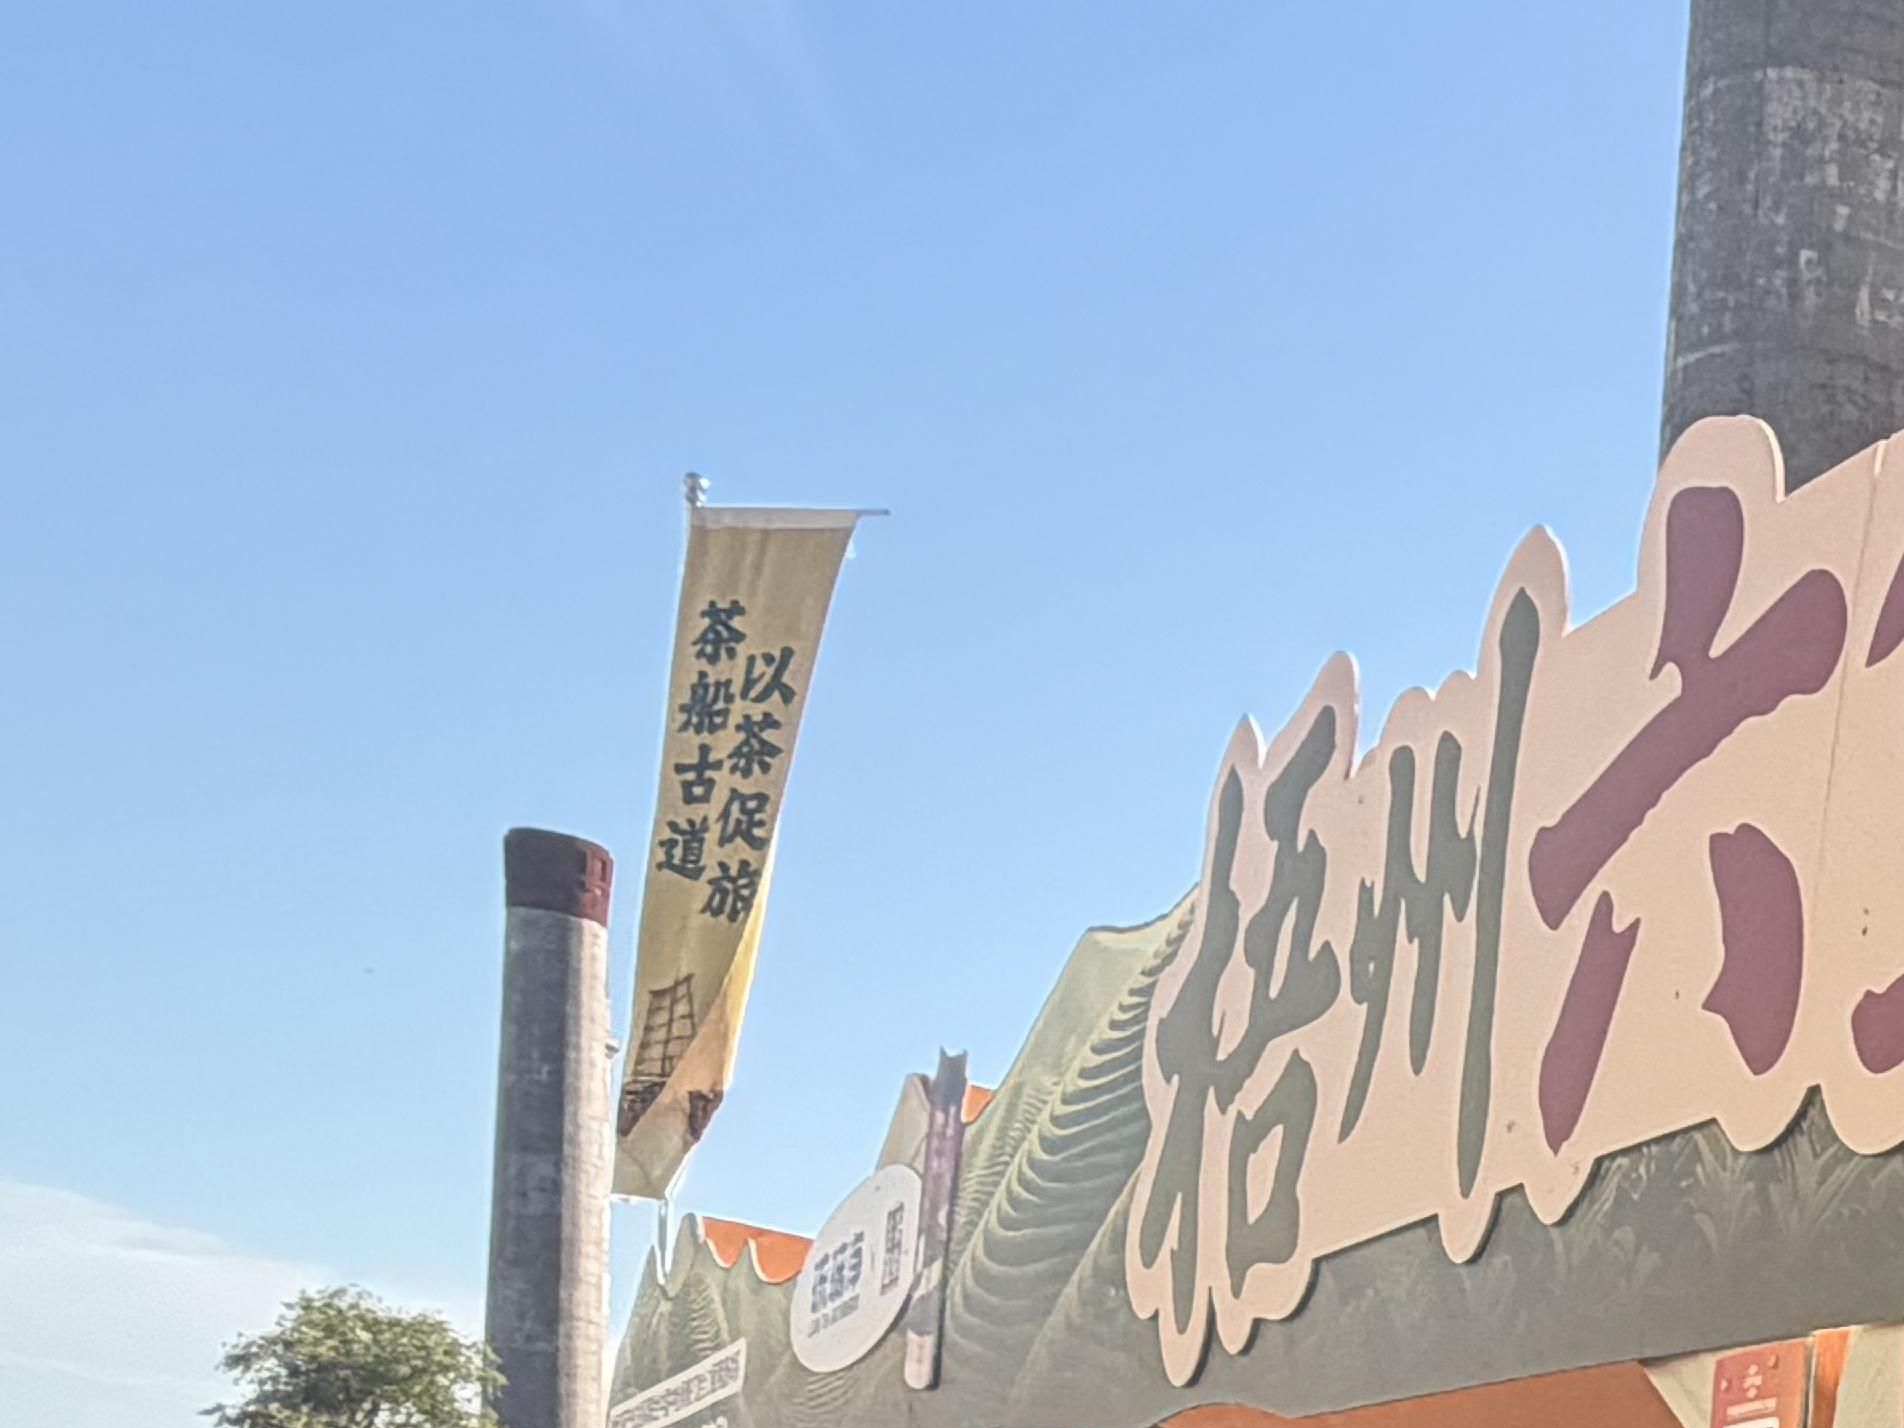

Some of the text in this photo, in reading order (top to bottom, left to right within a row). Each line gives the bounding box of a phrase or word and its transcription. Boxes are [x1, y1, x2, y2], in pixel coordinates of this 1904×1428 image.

[656, 600, 747, 882] 茶船古道
[700, 646, 797, 924] 以茶促旅
